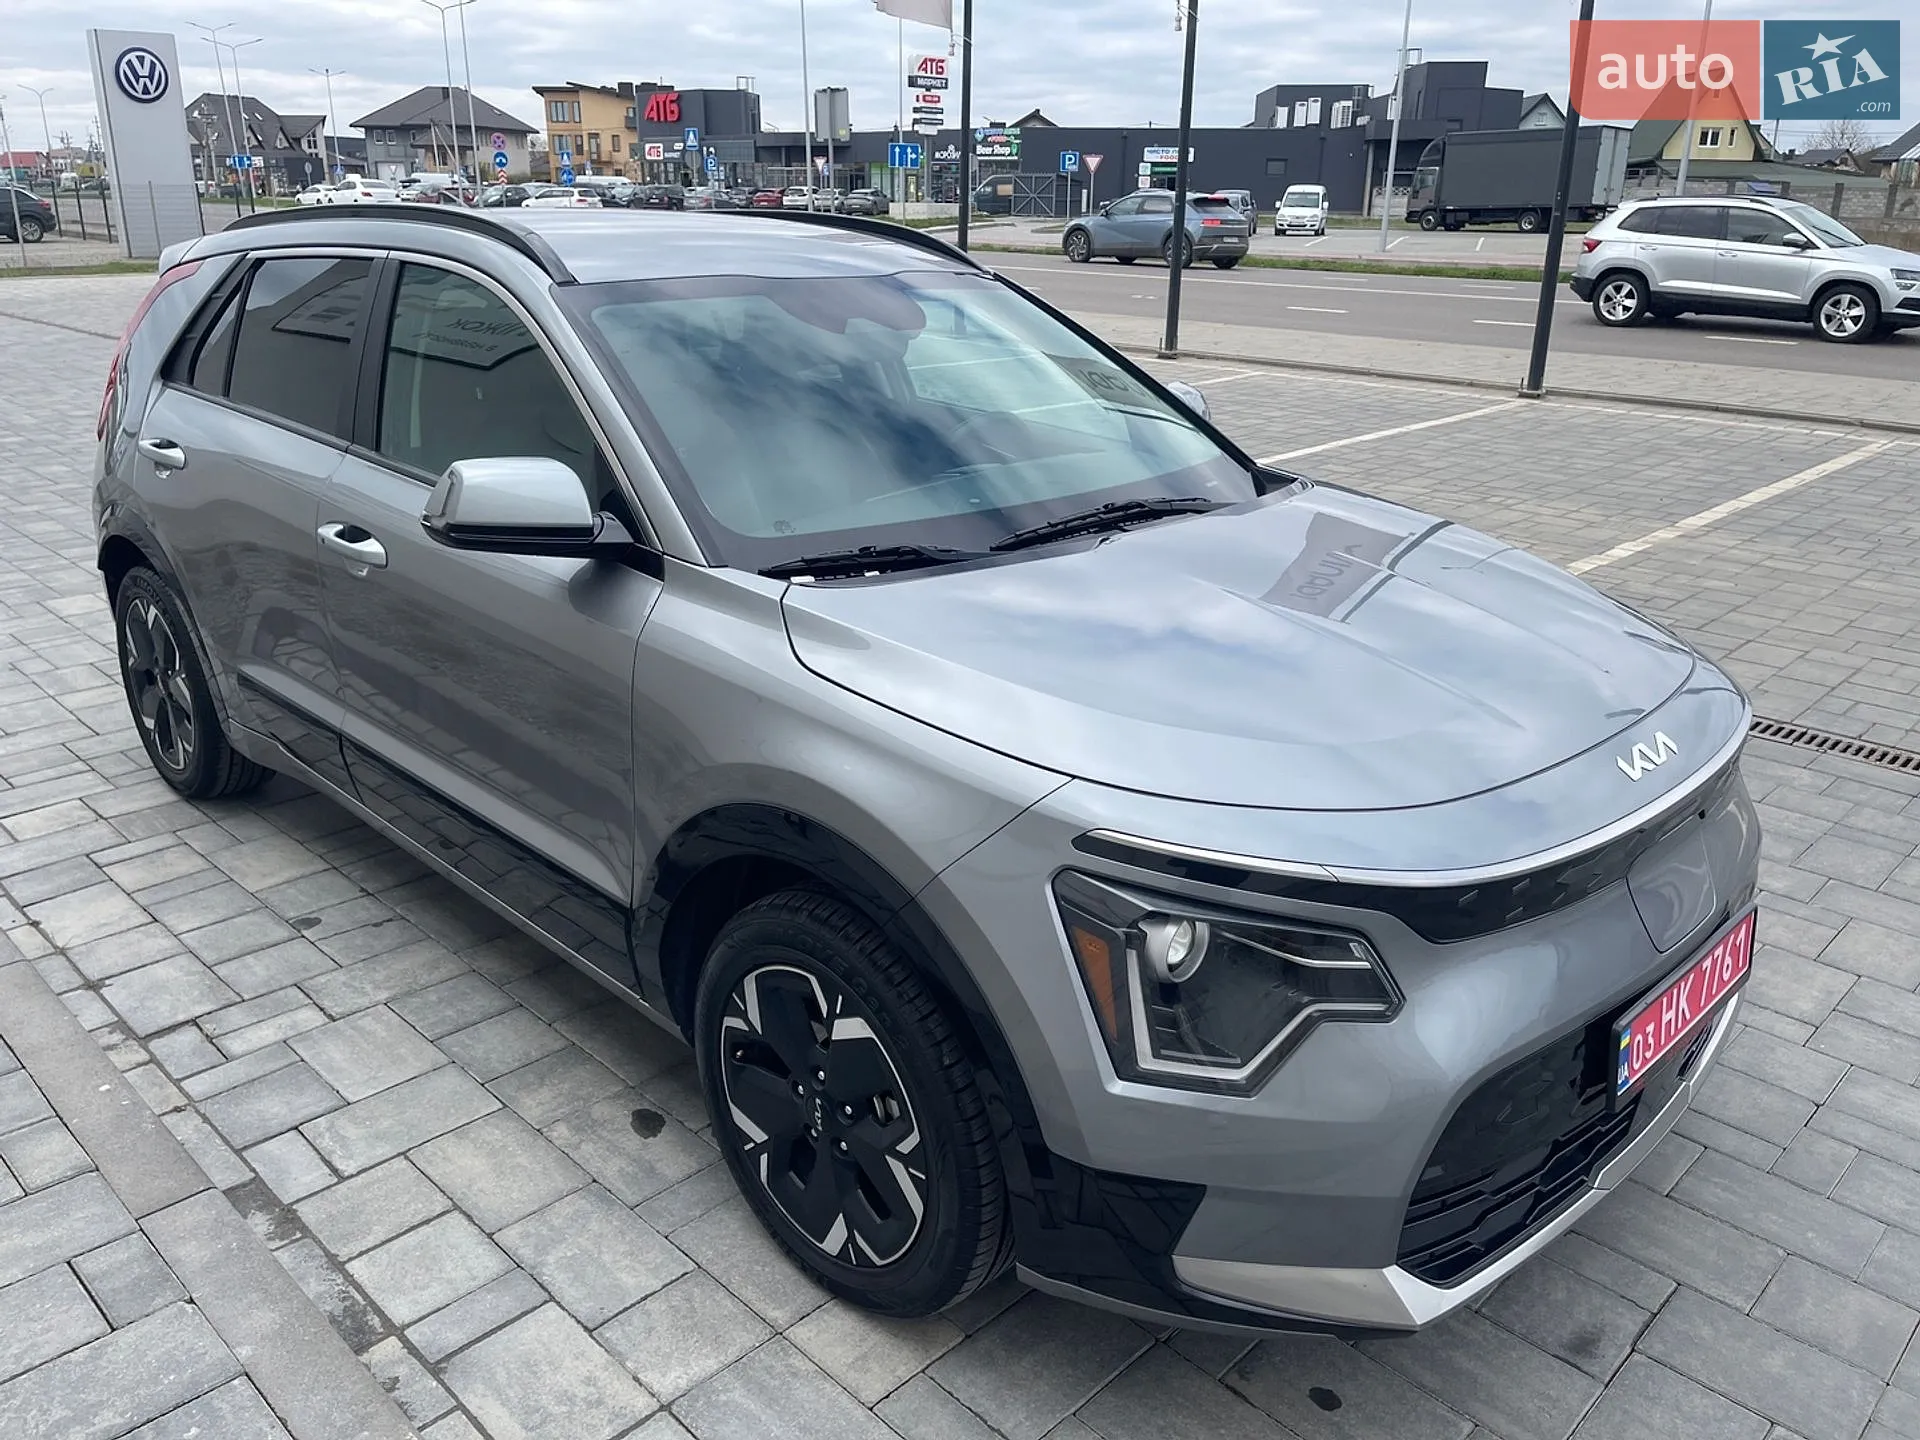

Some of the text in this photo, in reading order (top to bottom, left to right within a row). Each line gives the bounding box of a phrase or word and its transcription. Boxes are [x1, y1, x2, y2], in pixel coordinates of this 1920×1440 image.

[917, 57, 946, 76] АТБ
[644, 92, 681, 123] АТБ
[976, 144, 1011, 156] Beer Shop
[1616, 731, 1678, 782] KIA
[1632, 923, 1748, 1070] 03 HK 7761
[1617, 1063, 1629, 1084] UA
